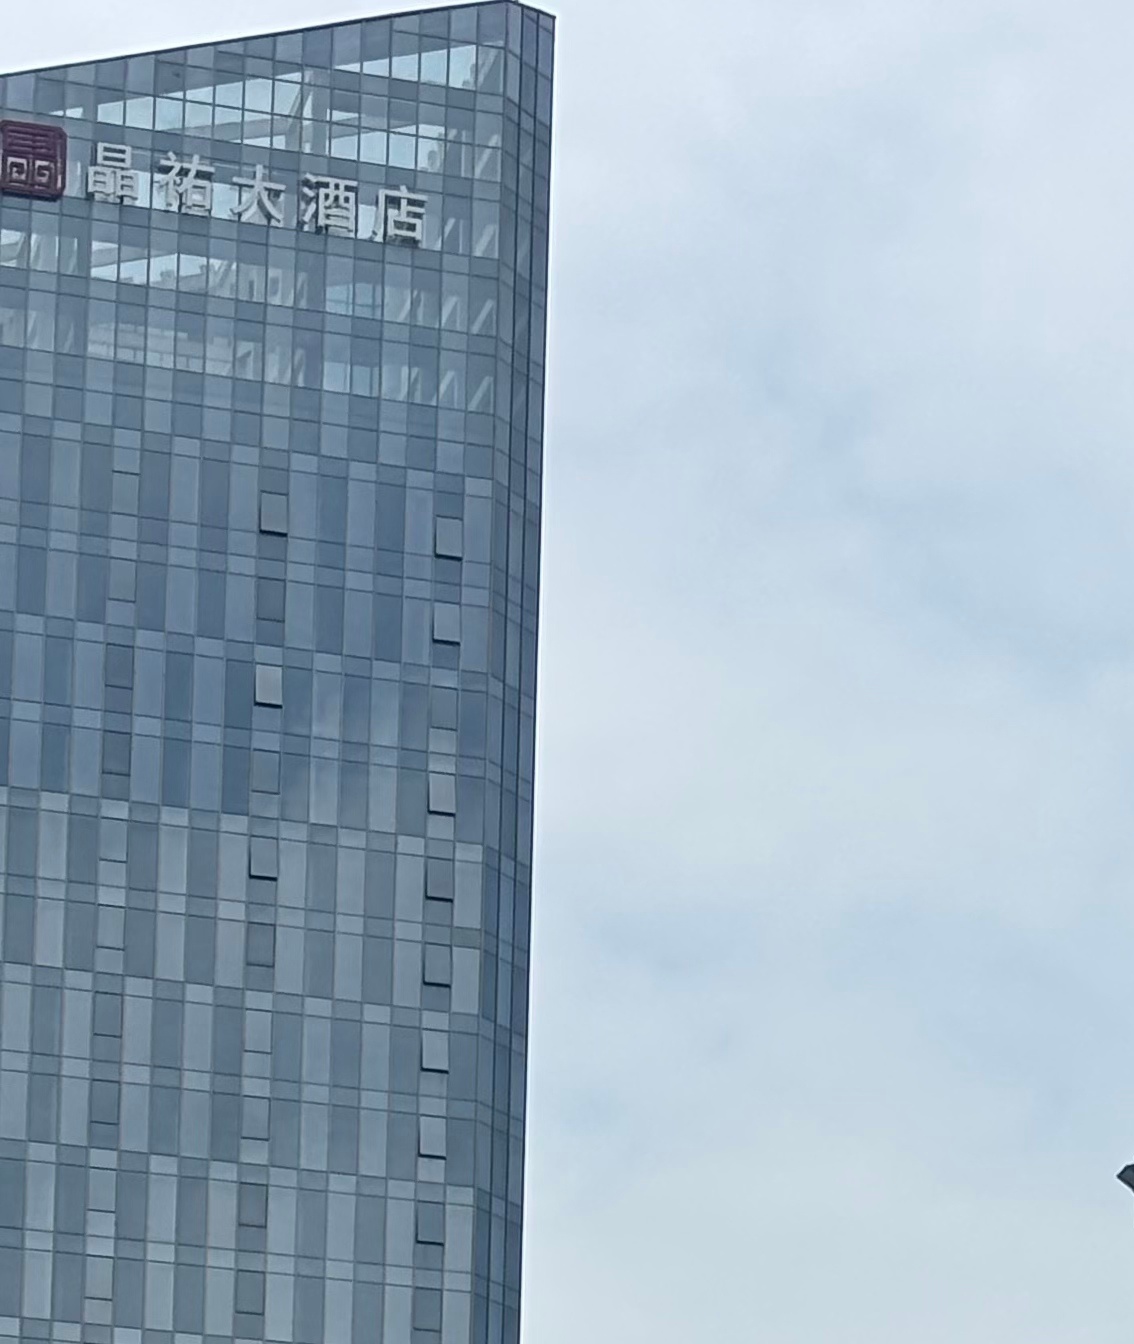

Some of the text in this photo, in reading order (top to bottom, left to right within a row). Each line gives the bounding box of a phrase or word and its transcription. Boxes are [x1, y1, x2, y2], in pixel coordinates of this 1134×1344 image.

[87, 142, 429, 248] 晶祐大酒店
